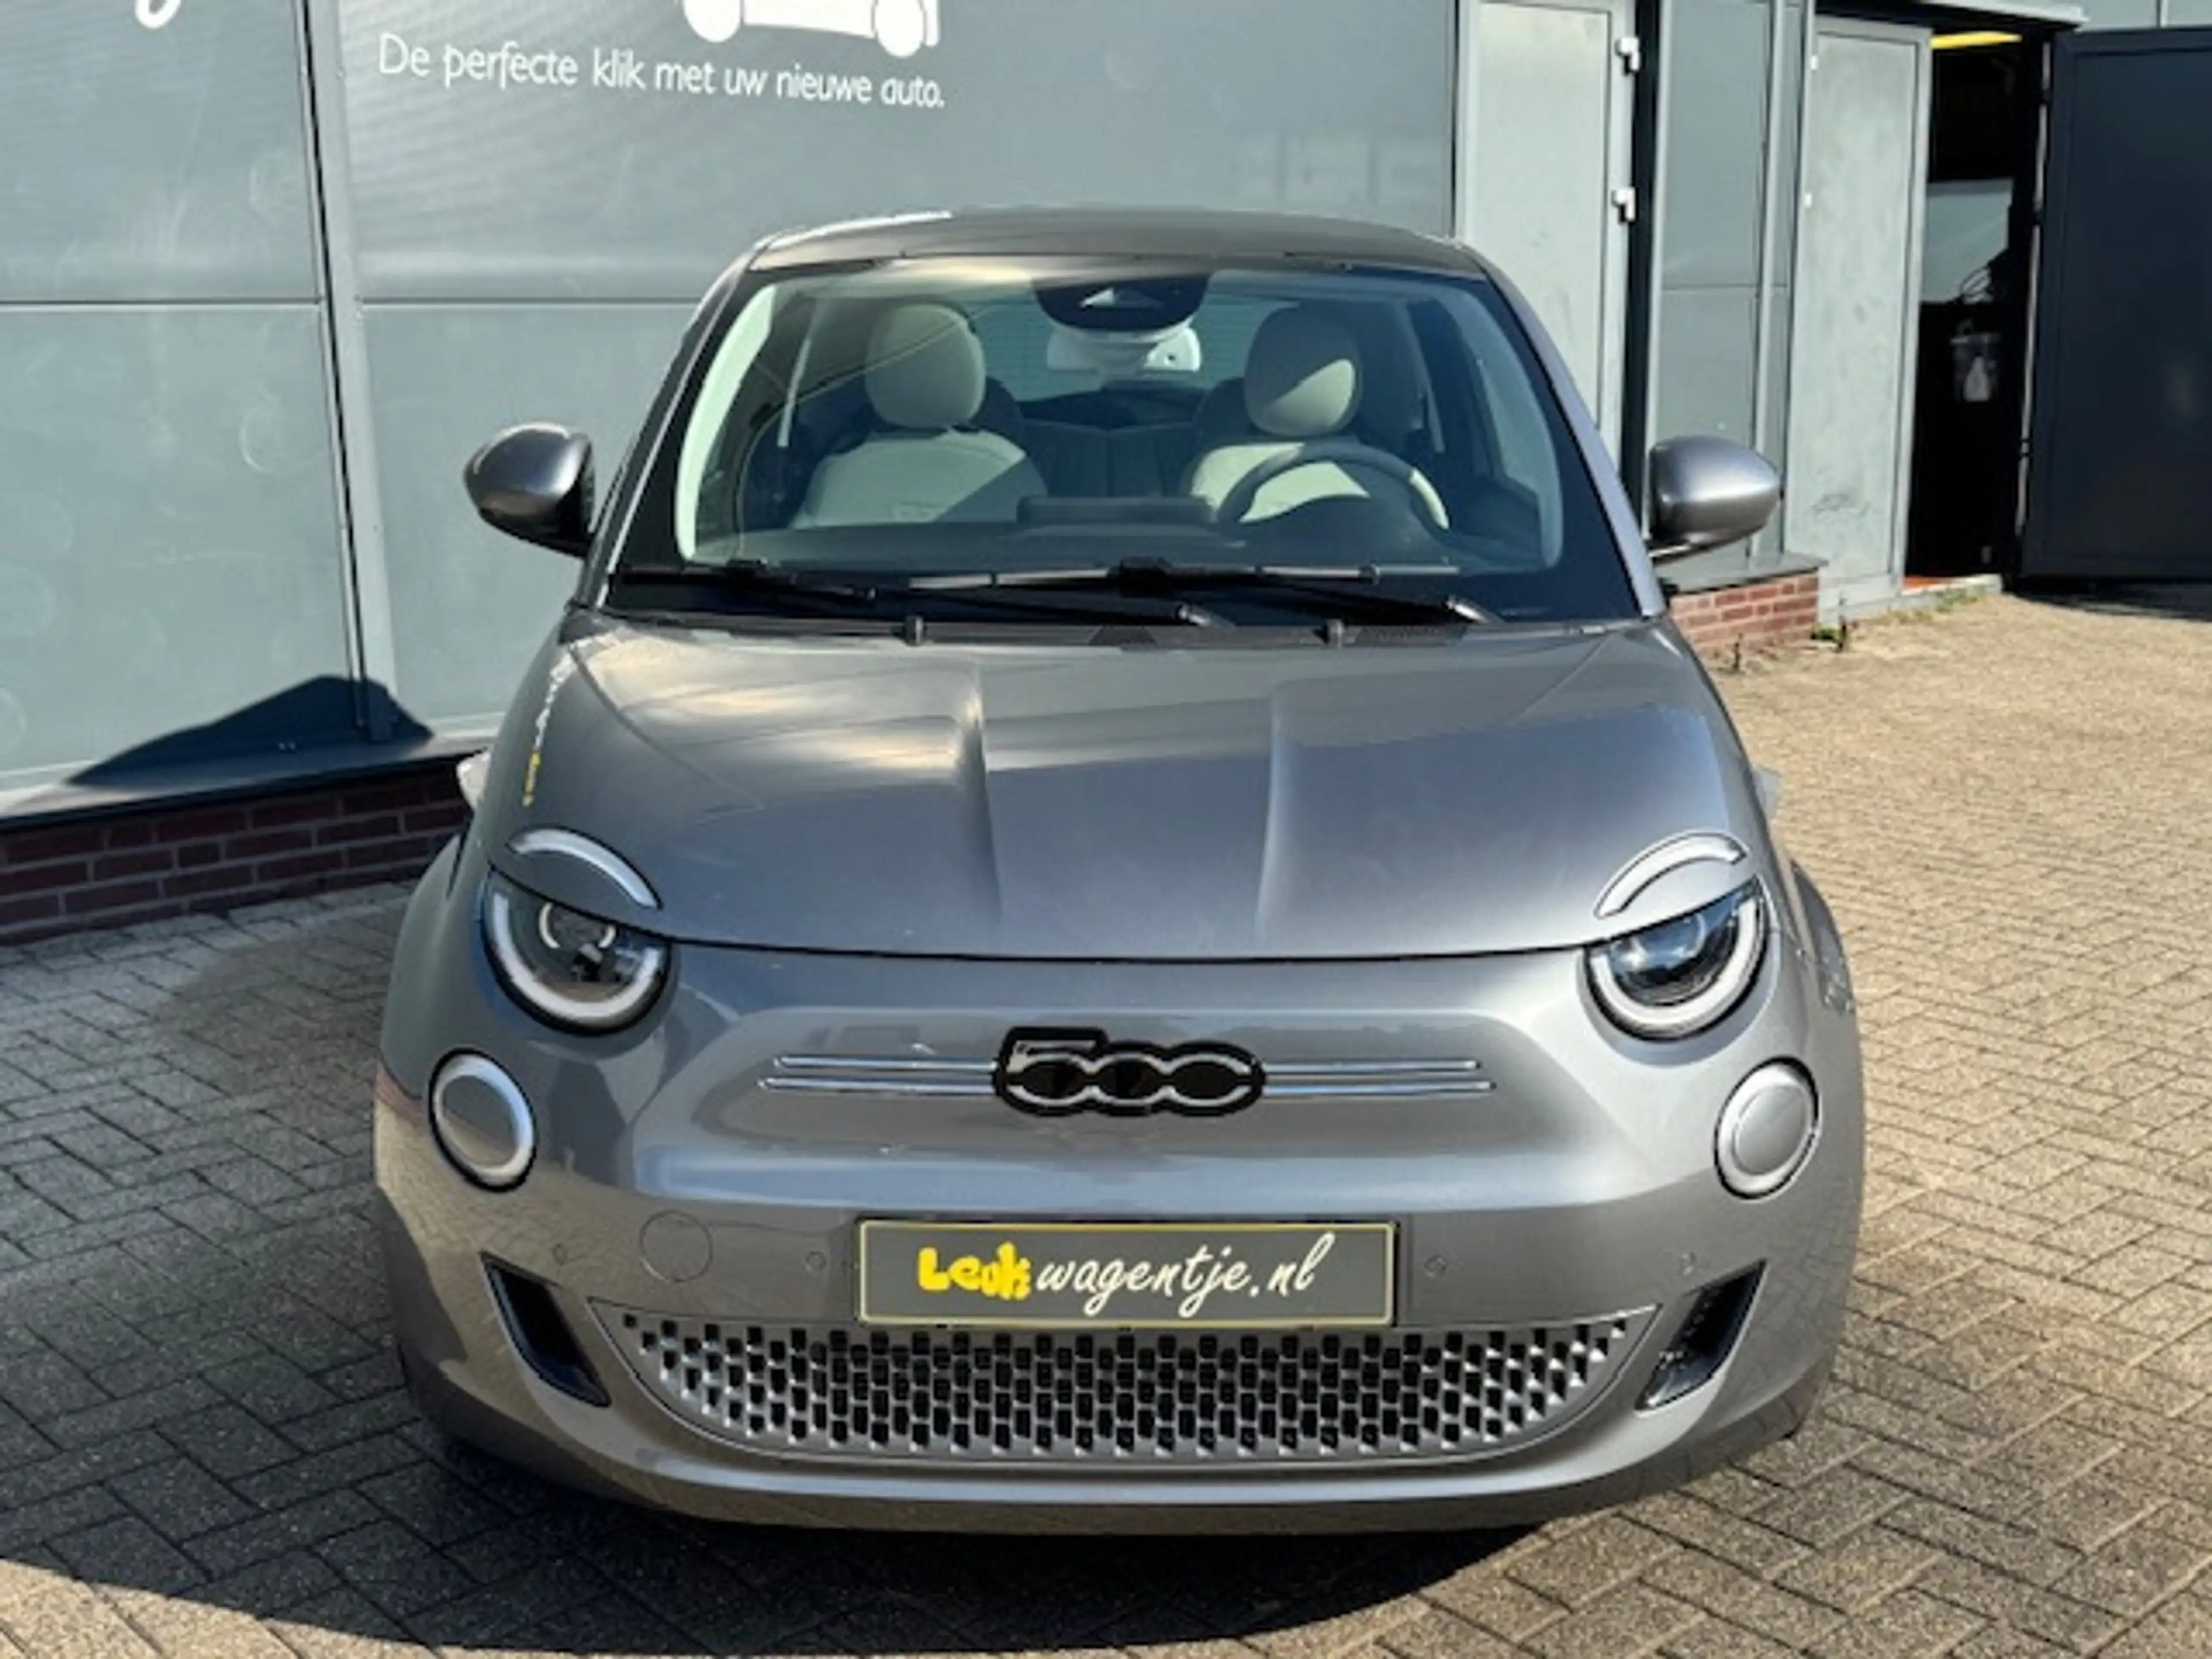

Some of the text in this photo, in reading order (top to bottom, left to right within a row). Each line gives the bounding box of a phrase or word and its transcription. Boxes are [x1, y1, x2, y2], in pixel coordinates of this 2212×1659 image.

[379, 32, 945, 108] De perfecte klik met uw nieuwe auto.
[992, 1027, 1265, 1117] 500
